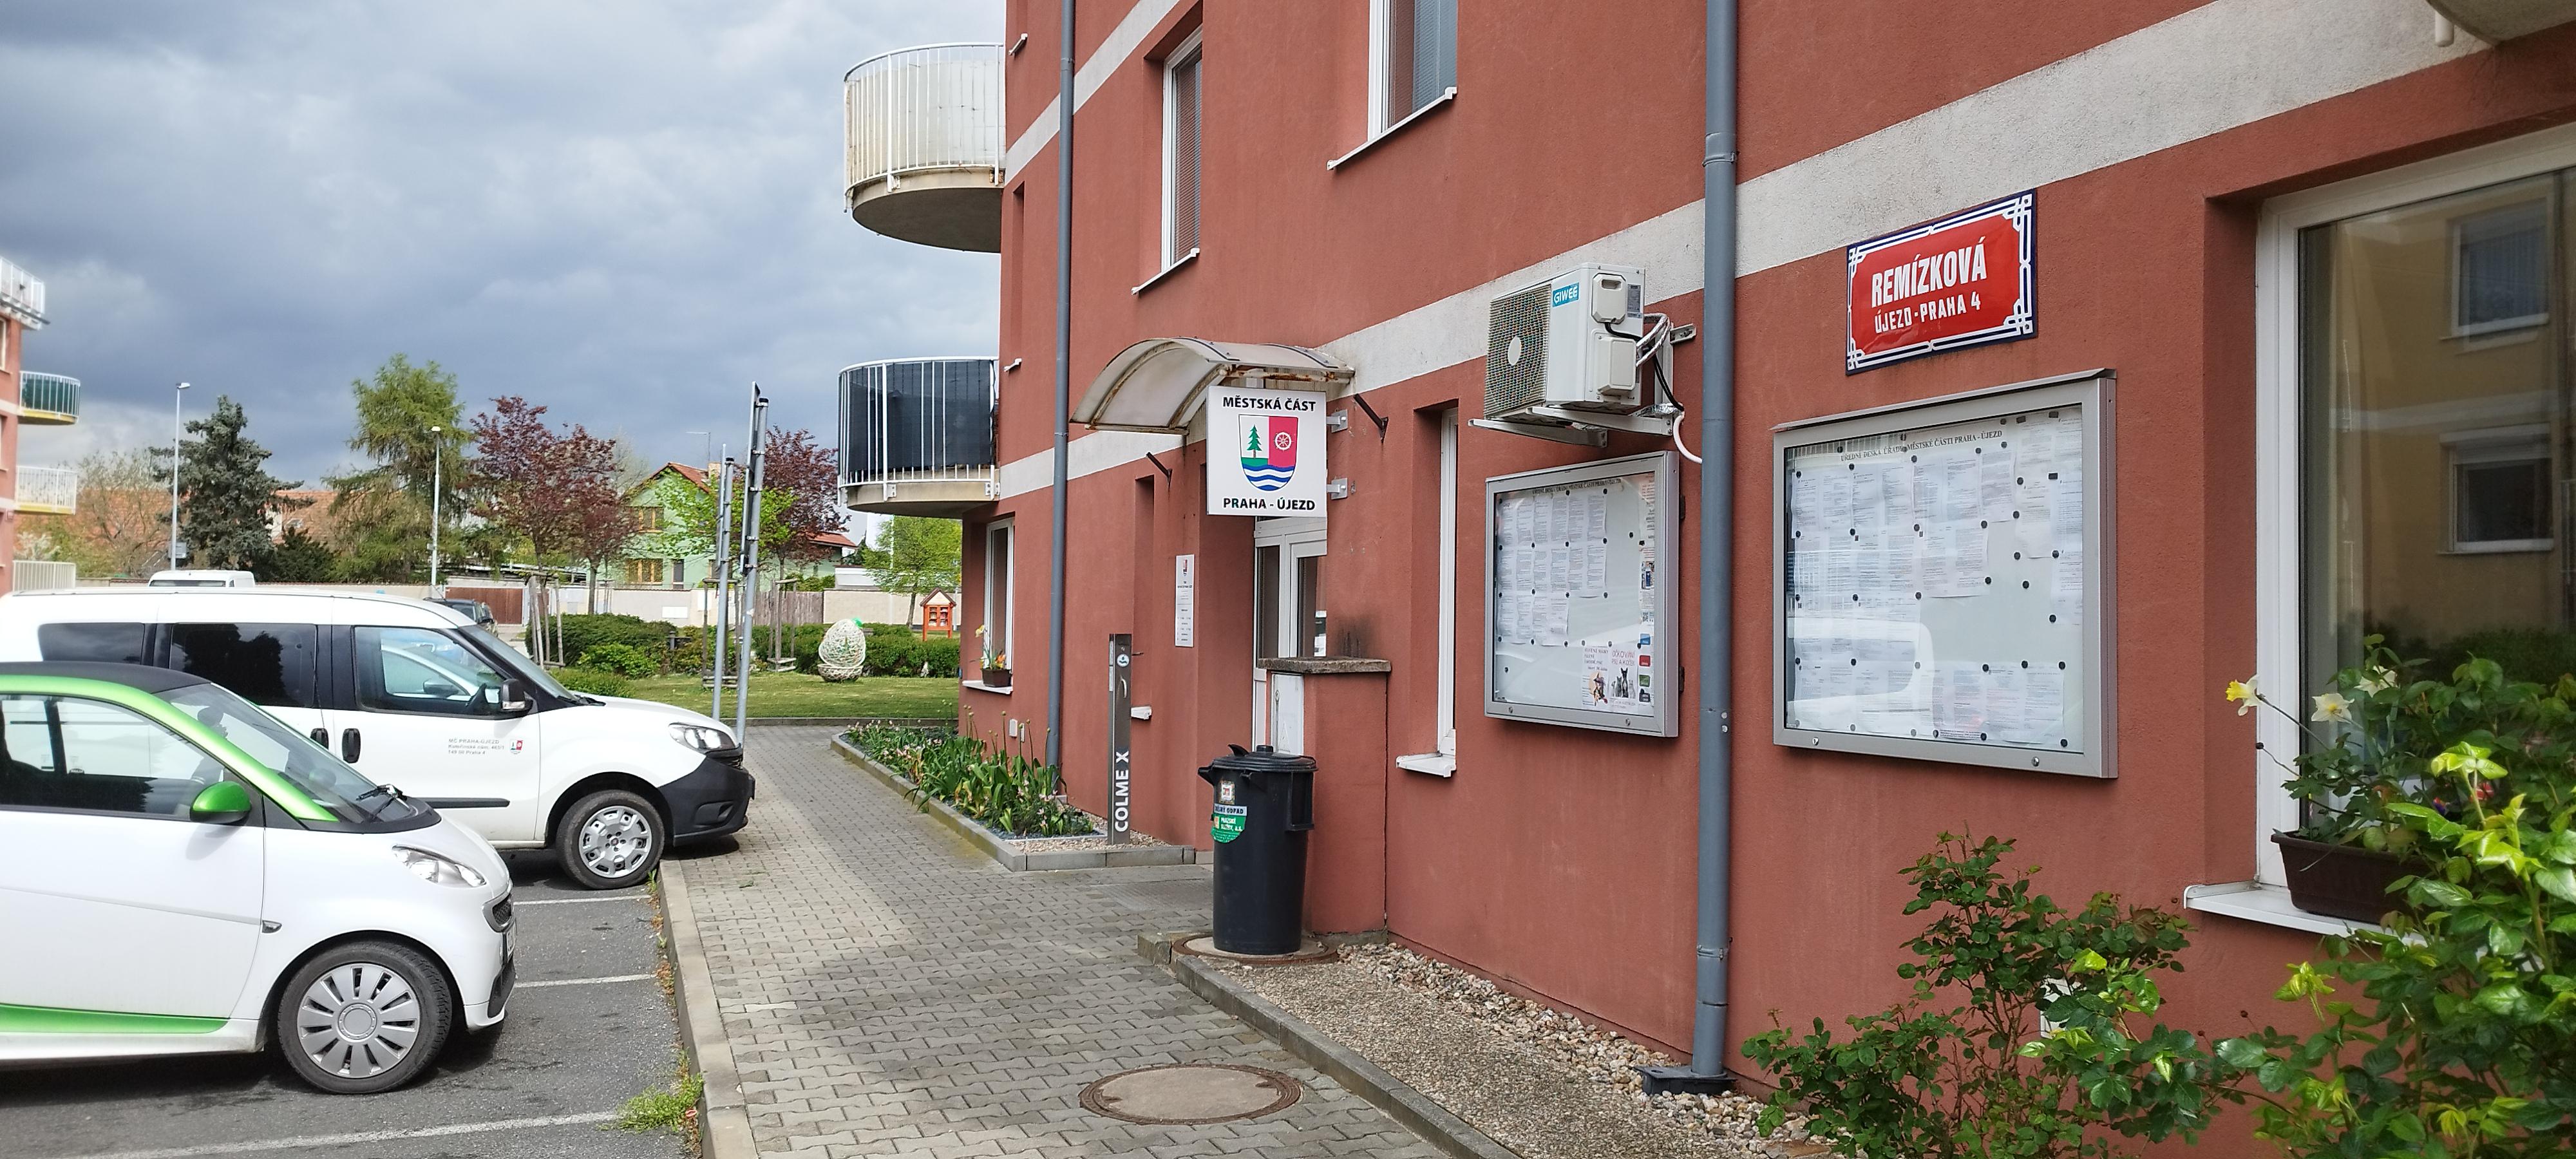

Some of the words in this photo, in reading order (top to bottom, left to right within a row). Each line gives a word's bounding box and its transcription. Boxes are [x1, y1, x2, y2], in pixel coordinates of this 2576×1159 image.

[1871, 235, 1987, 308] REMÍZKOVÁ
[1553, 284, 1578, 304] GIWEE
[1874, 307, 1913, 334] ÚJEZD
[1920, 294, 1967, 323] PRAHA
[1971, 291, 1981, 310] 4
[1222, 395, 1282, 410] MĚSTSKÁ
[1285, 397, 1316, 411] ČÁST
[1907, 438, 1933, 450] MĚSTSKÉ
[1935, 438, 1953, 446] ČÁSTI
[1955, 435, 1976, 444] PRAHA
[1981, 430, 2002, 439] ÚJEZD
[1224, 498, 1267, 509] PRAHA
[1277, 497, 1315, 511] ÚJEZD
